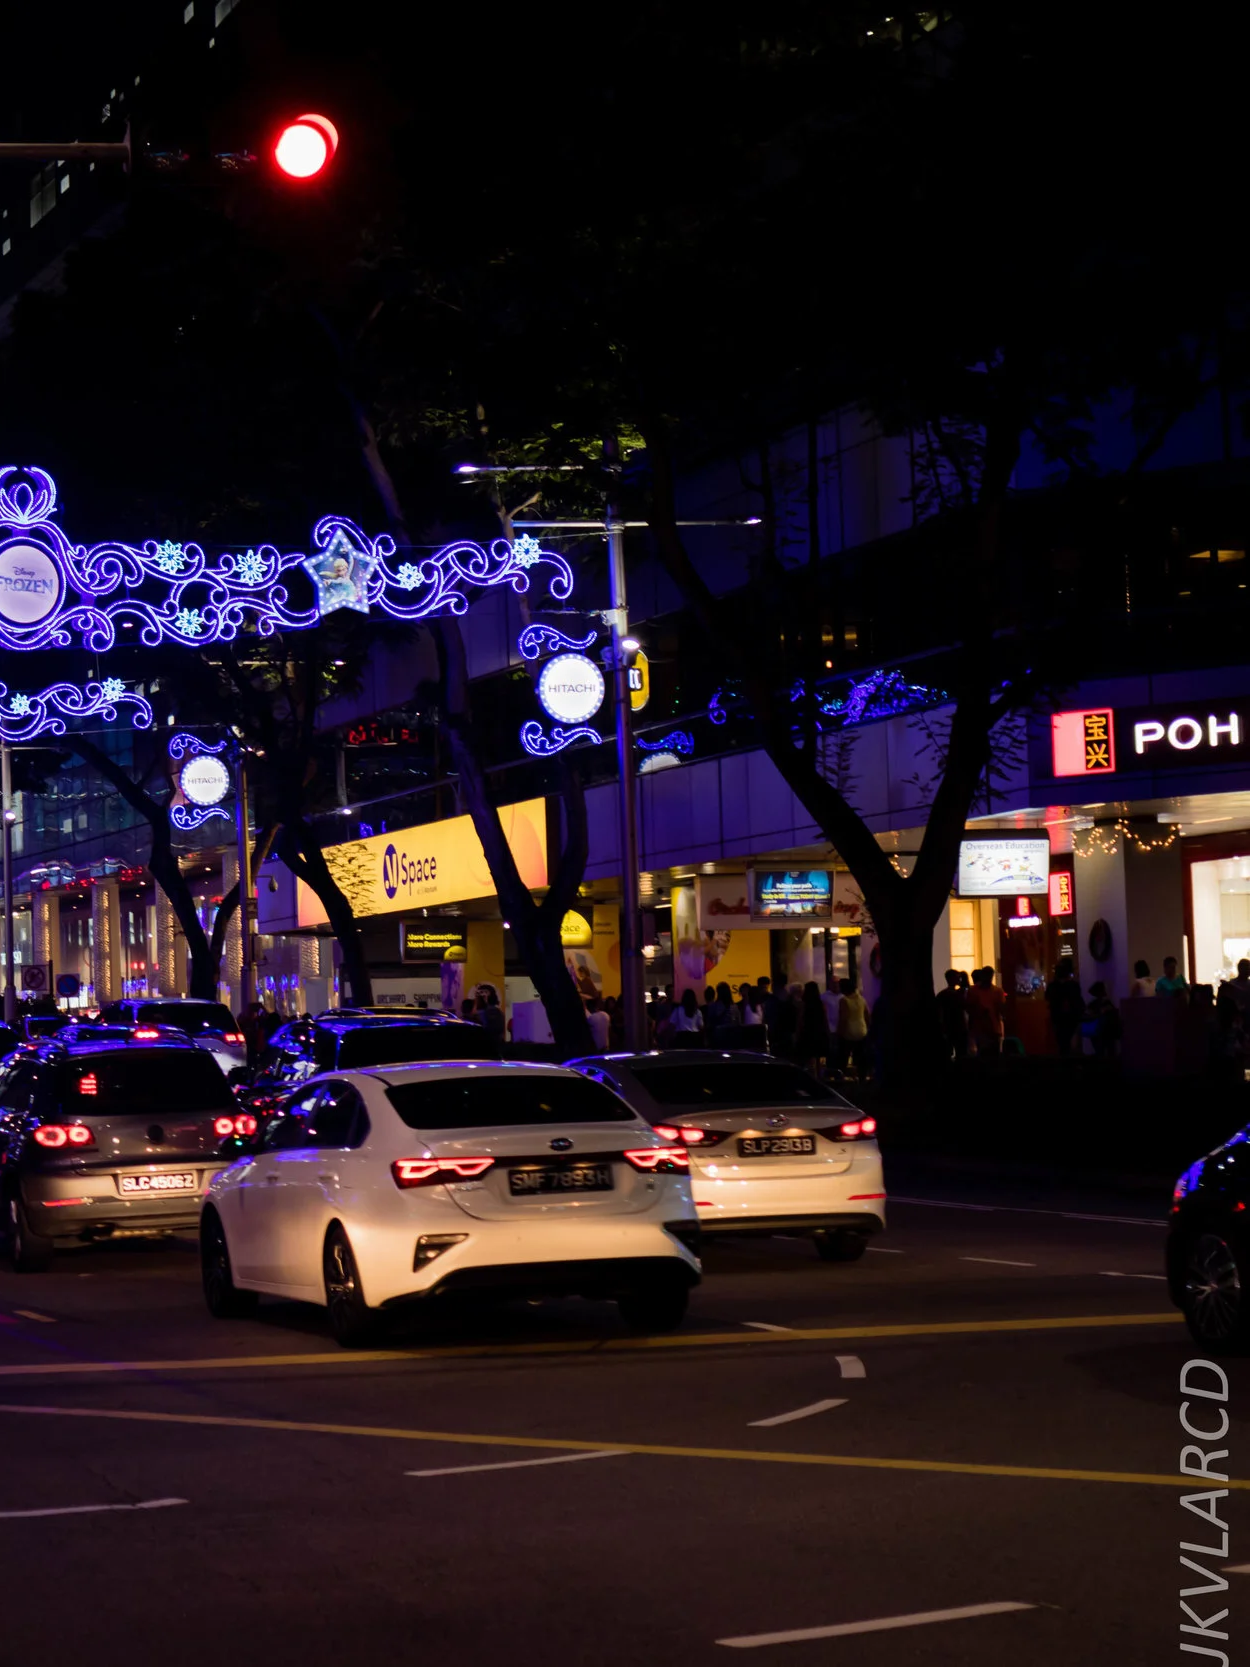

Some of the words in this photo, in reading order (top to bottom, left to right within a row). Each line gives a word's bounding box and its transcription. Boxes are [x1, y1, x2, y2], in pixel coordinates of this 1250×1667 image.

[12, 566, 35, 578] Disney
[548, 684, 596, 694] HITACHI
[1134, 712, 1240, 754] POH
[187, 776, 224, 785] HITACHI
[401, 852, 437, 897] Space
